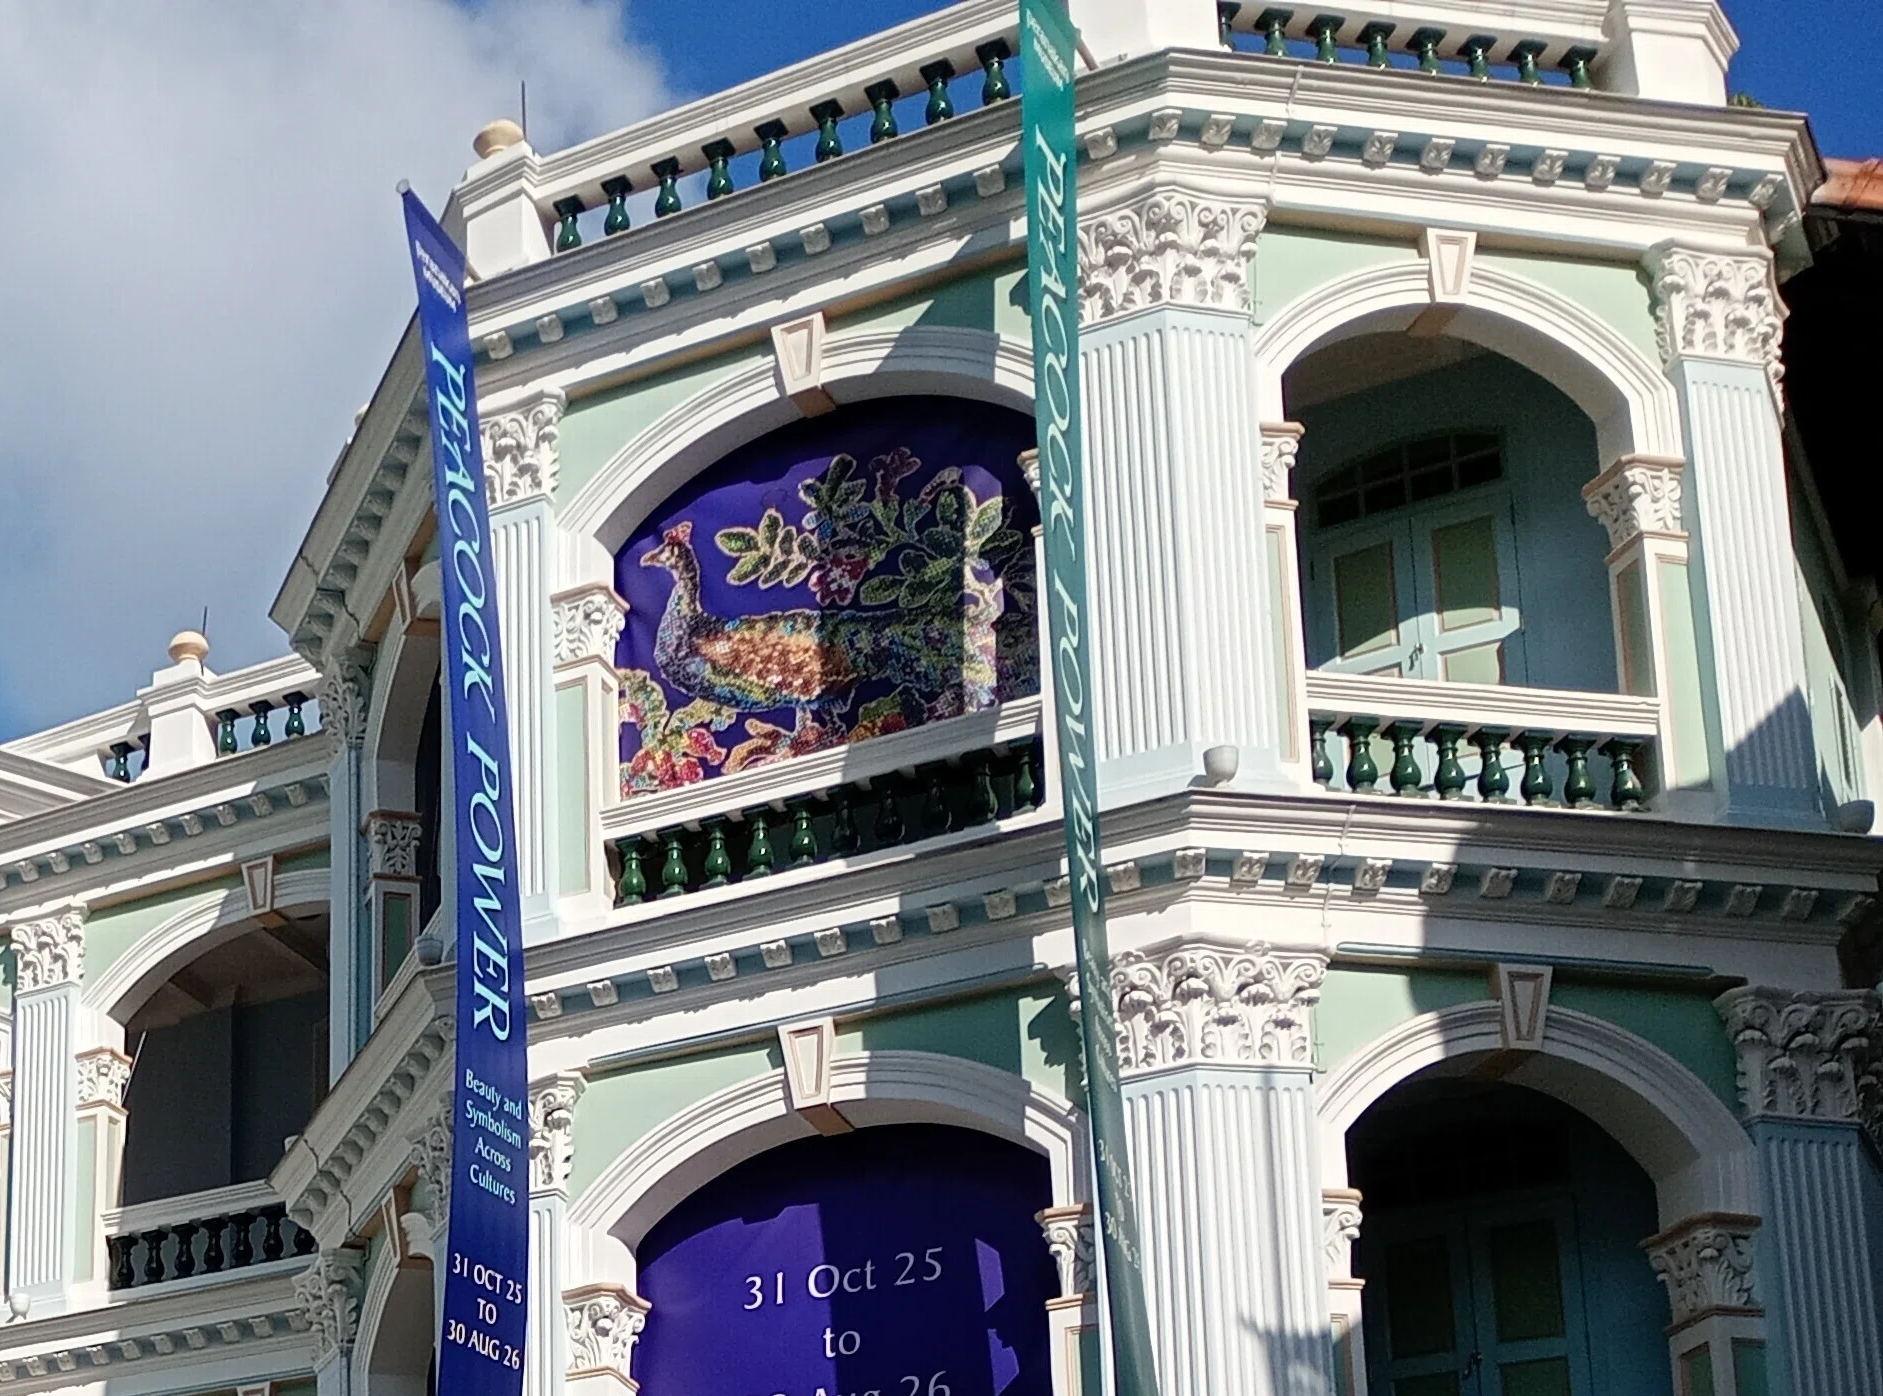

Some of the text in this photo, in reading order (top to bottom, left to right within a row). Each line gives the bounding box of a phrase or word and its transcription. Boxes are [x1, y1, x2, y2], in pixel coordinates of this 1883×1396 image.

[1035, 123, 1077, 562] PEACOCK
[431, 341, 496, 723] PEACOCK
[467, 731, 512, 1042] POWER
[1054, 568, 1099, 914] POWER
[465, 1068, 522, 1120] Beauty and
[465, 1099, 522, 1150] Symbolism
[475, 1136, 511, 1172] Across
[469, 1163, 516, 1206] Cultures
[452, 1252, 523, 1304] 31 OCT 25
[743, 1246, 943, 1310] 31 Oct 25
[477, 1297, 497, 1324] TO
[447, 1319, 520, 1370] 30 AUG 26
[822, 1327, 861, 1358] to
